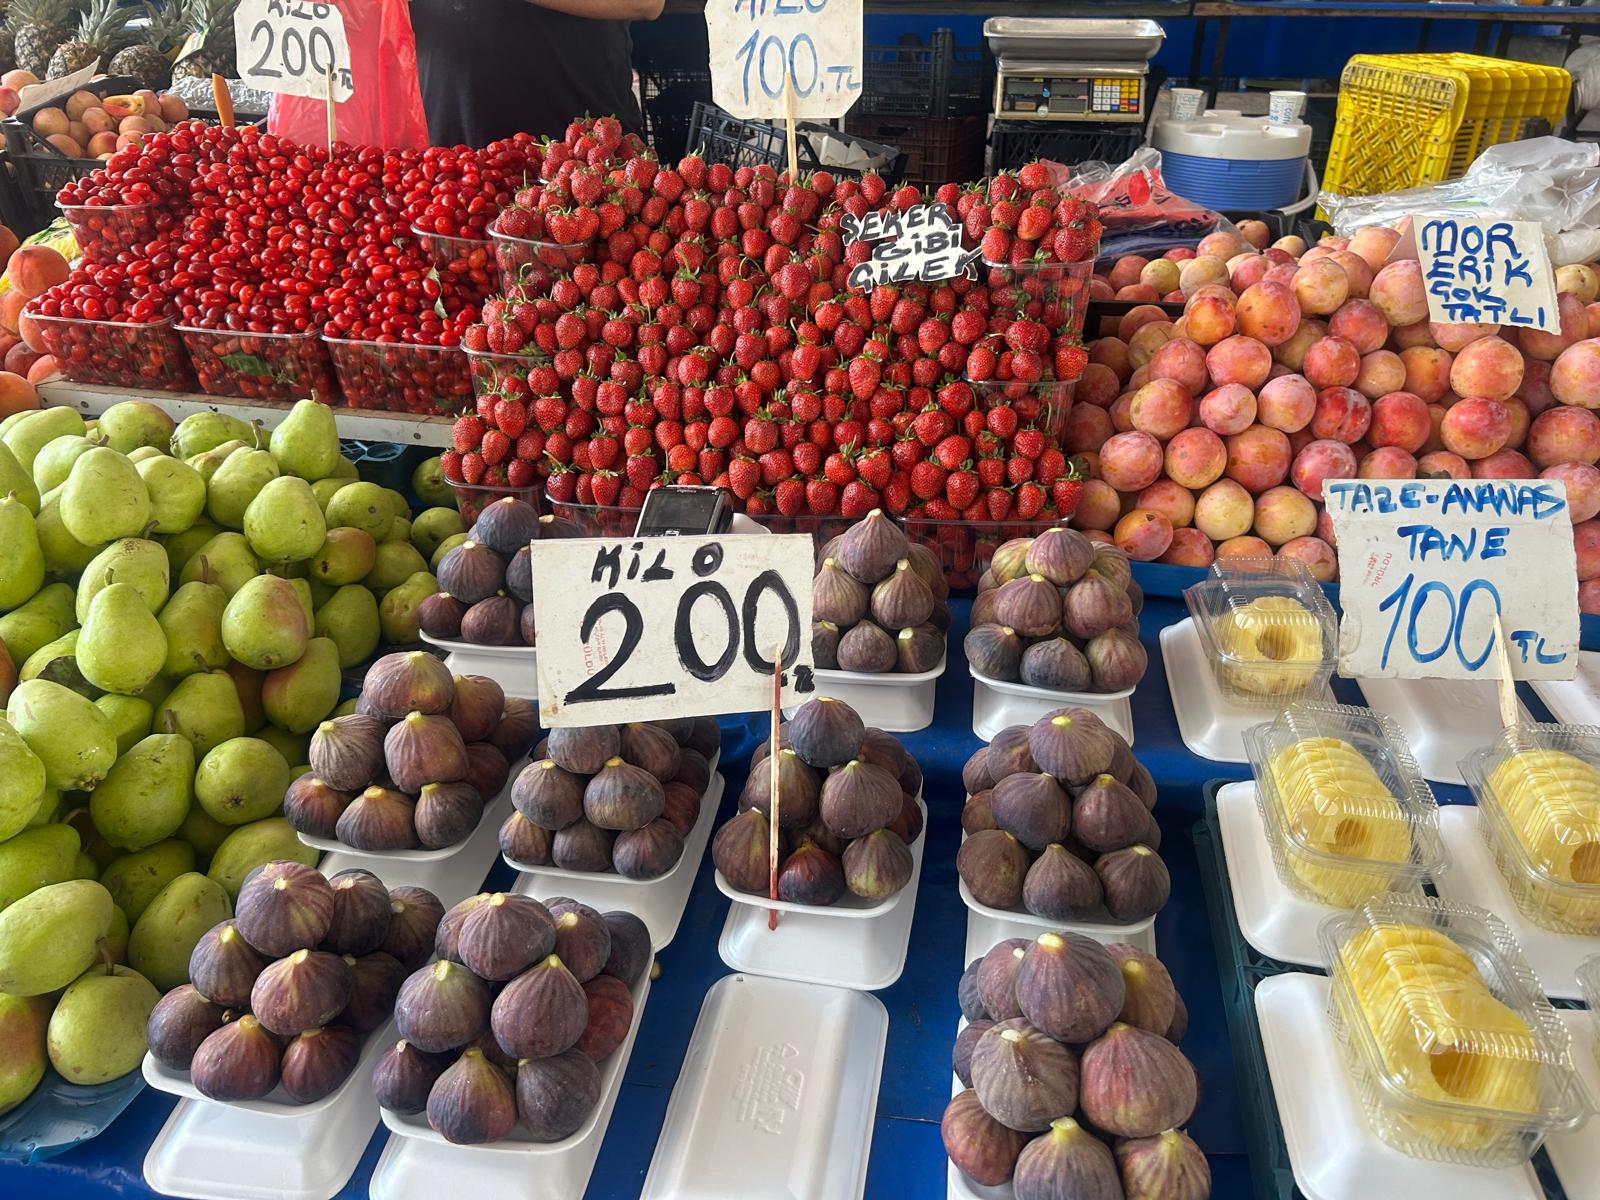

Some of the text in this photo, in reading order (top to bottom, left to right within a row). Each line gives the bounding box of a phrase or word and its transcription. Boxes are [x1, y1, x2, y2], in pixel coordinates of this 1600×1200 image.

[1422, 219, 1522, 259] MOR
[1397, 524, 1510, 562] TANE
[1379, 573, 1567, 671] 100 TL
